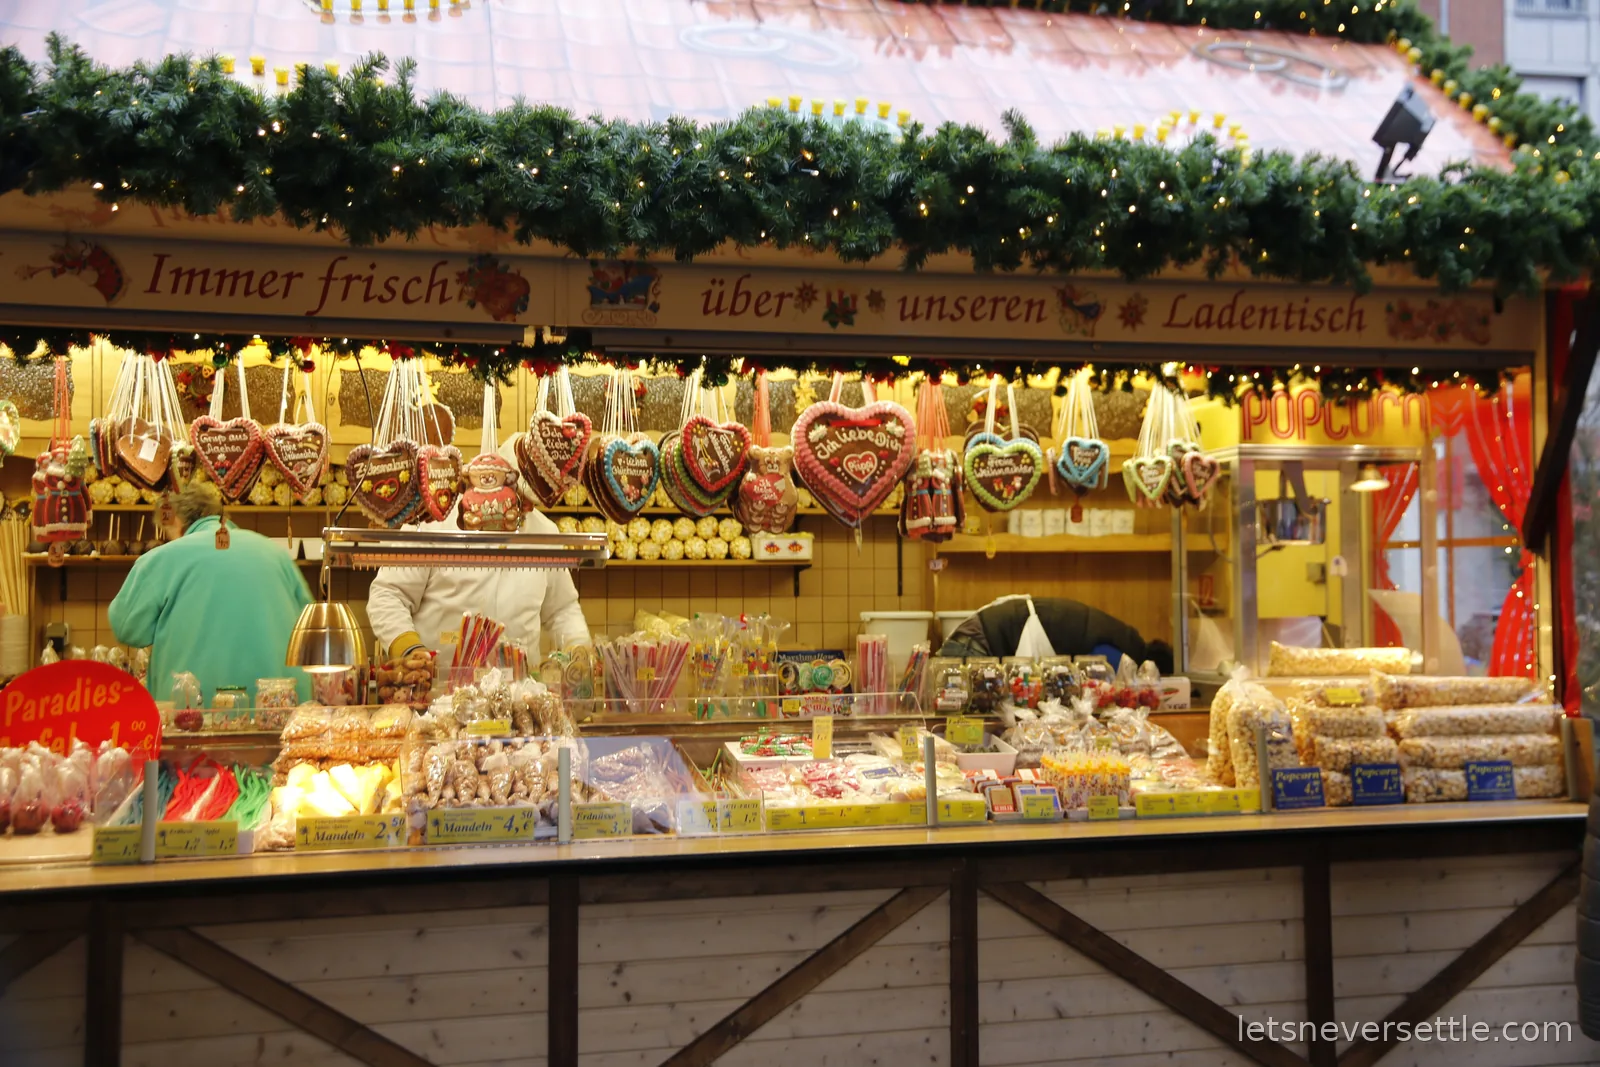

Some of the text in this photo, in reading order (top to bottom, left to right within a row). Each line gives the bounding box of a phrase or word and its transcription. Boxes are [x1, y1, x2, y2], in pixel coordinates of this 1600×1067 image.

[143, 253, 1368, 333] Immer frisch über unseren Ladentisch
[229, 434, 249, 442] aus
[545, 438, 570, 450] liebe
[816, 427, 902, 459] Ich liebe Dich
[4, 676, 135, 727] Paradies-
[443, 821, 493, 833] Mandeln
[312, 829, 365, 841] Mandeln
